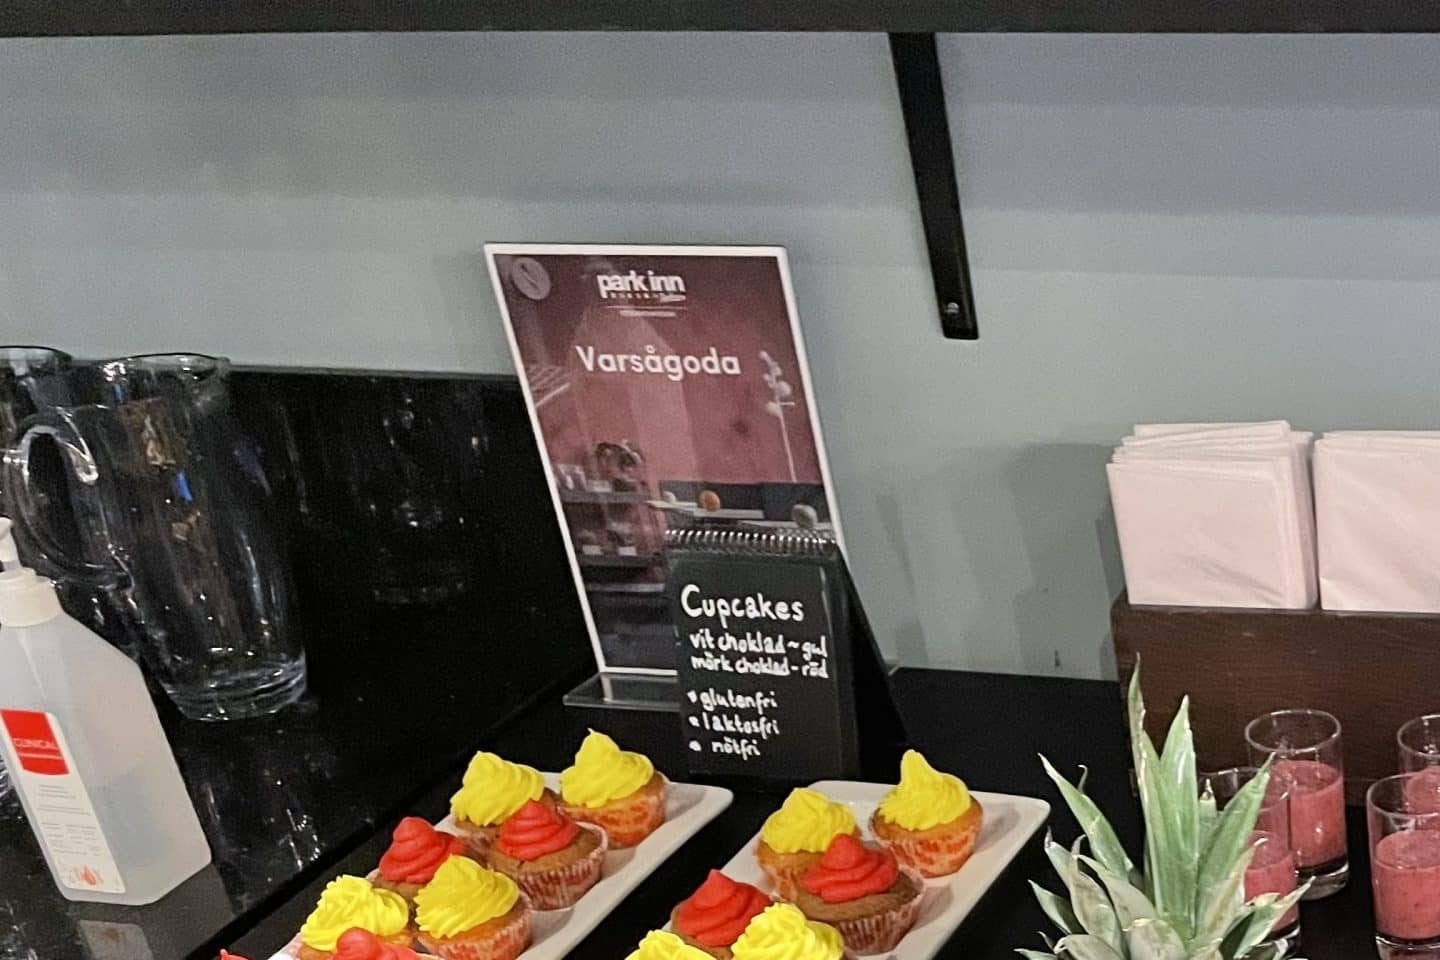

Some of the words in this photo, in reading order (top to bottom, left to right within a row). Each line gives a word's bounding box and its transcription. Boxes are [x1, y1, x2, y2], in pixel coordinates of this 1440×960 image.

[596, 269, 649, 299] park
[648, 269, 687, 292] inn
[575, 344, 742, 381] Varsågoda
[680, 584, 804, 629] Cupcakes
[689, 628, 715, 649] vit
[717, 631, 786, 654] choklad
[801, 635, 828, 661] gul
[690, 651, 734, 672] mörk
[735, 656, 791, 676] choklad
[801, 658, 829, 679] röd
[699, 687, 778, 715] glutenfri
[702, 711, 780, 740] laktosfri
[711, 735, 761, 761] nötfri
